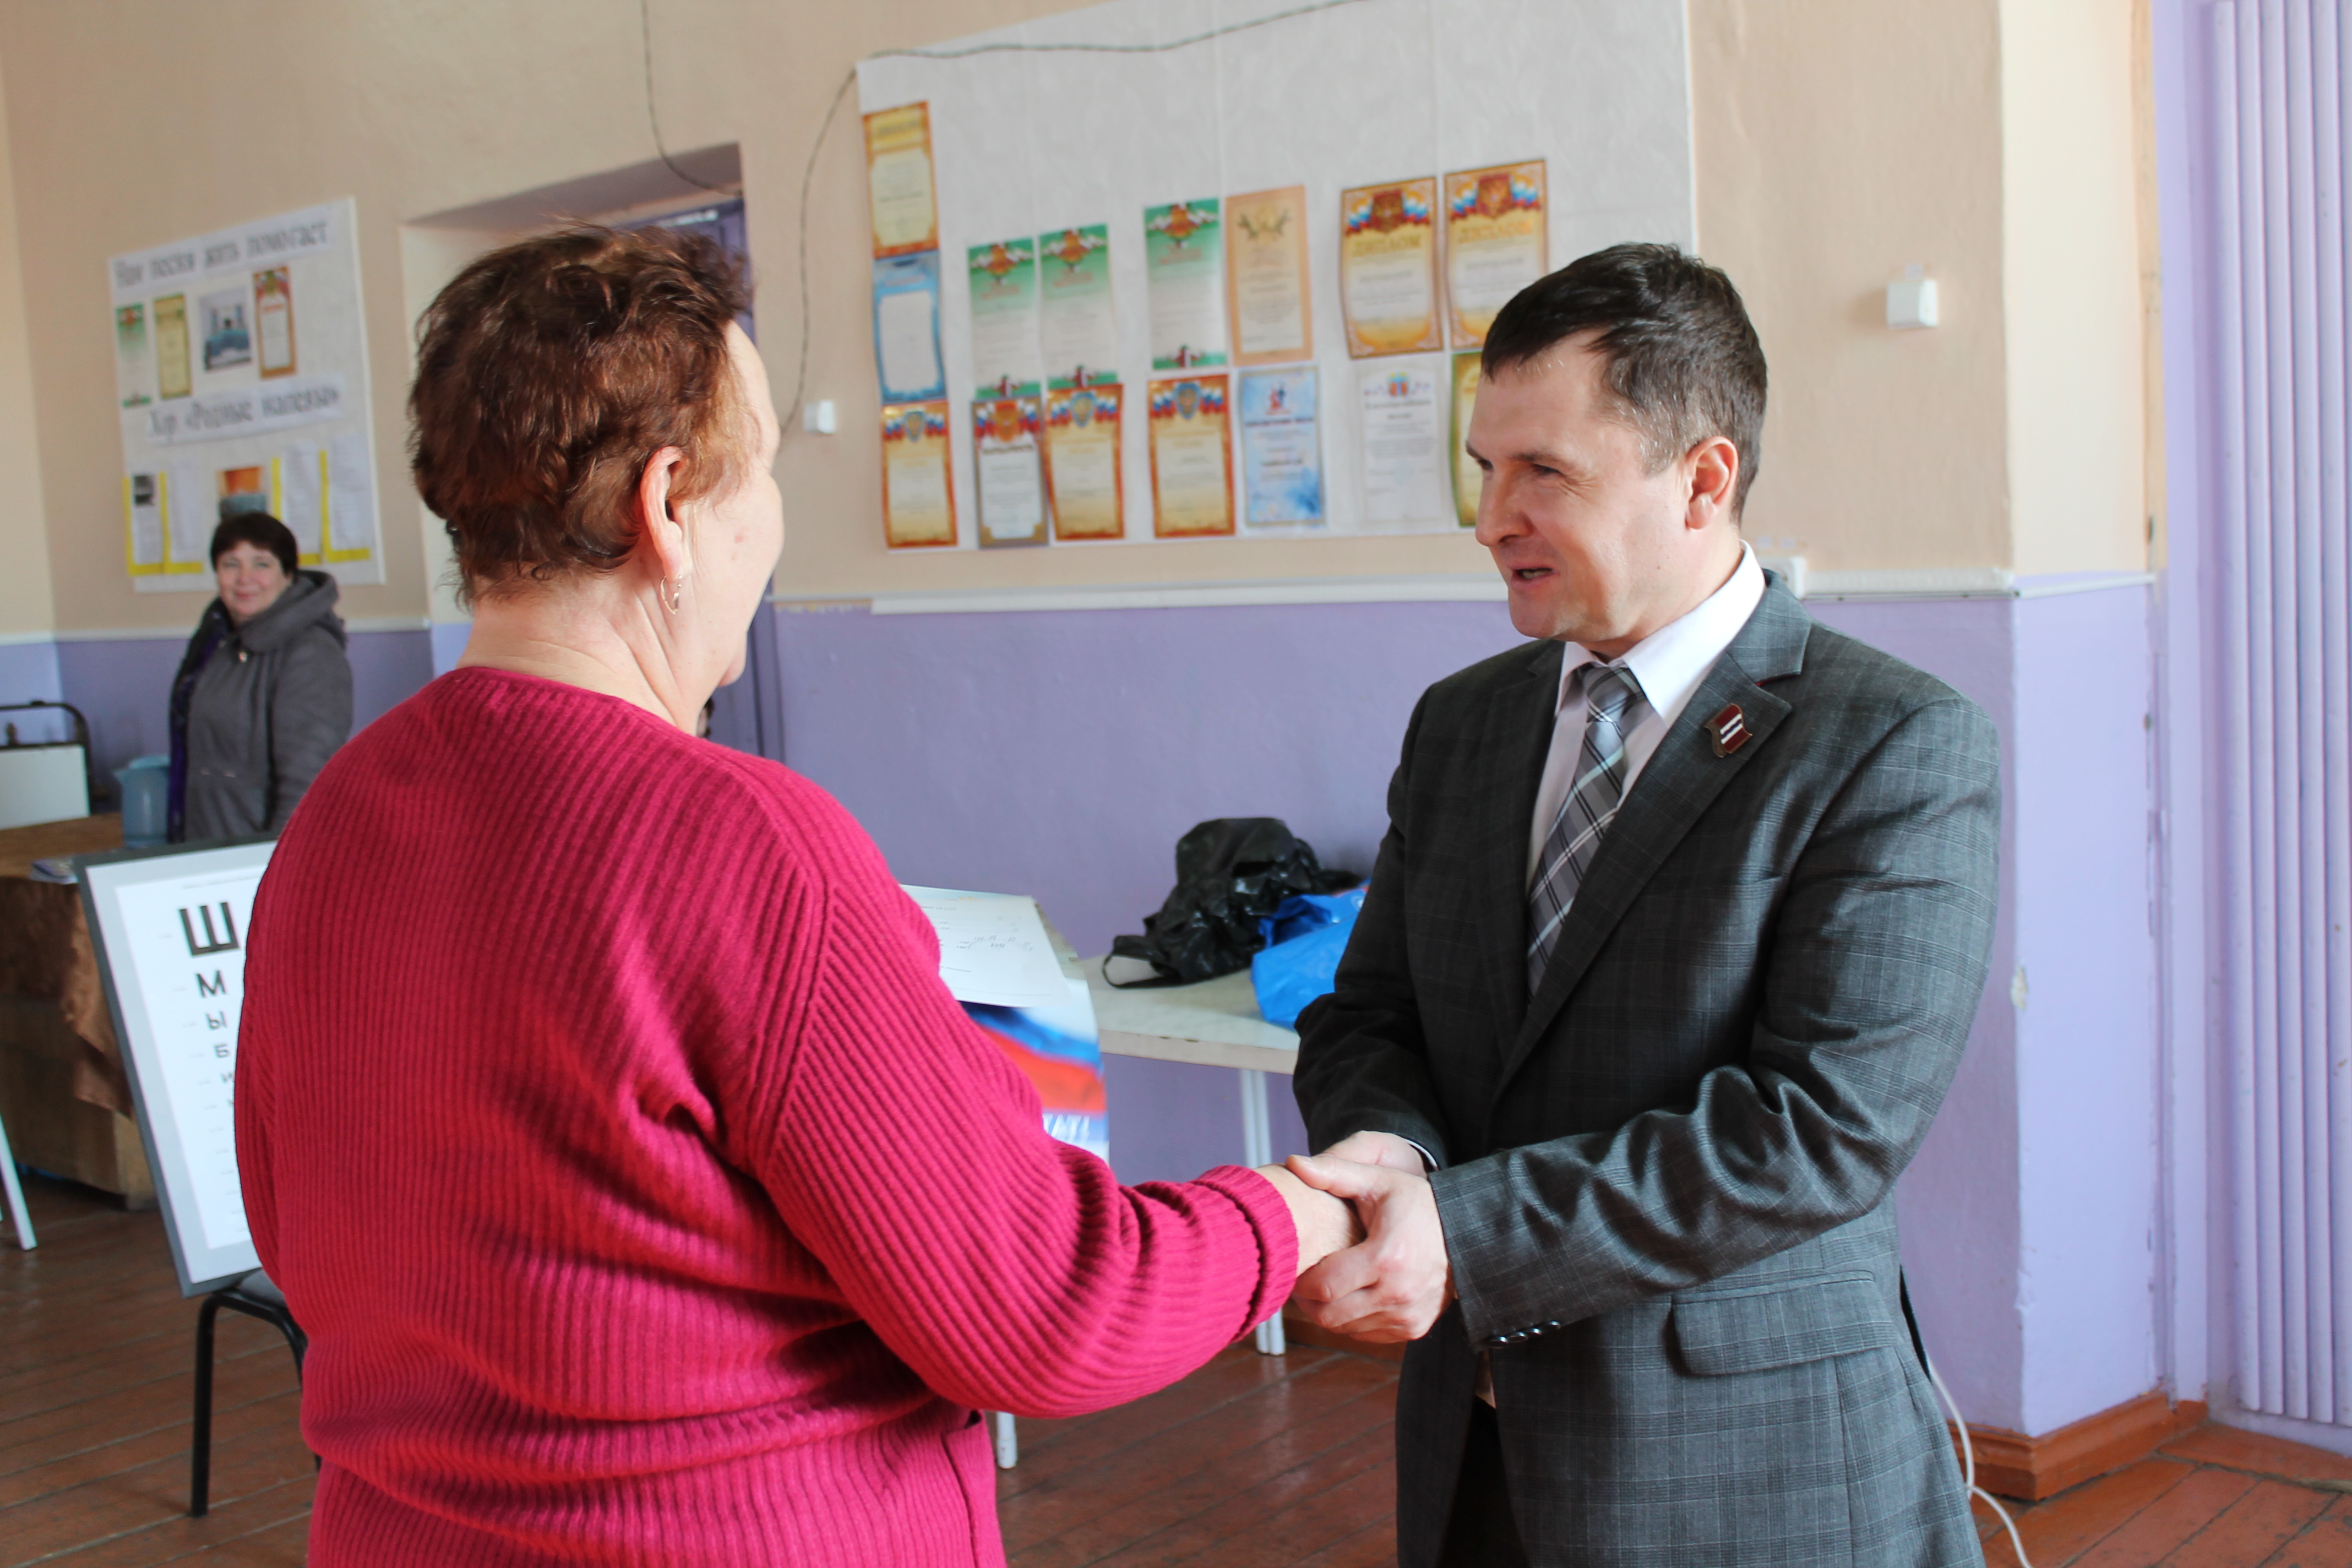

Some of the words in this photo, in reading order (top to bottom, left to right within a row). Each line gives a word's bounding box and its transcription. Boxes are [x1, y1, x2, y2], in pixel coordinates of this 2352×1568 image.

[178, 901, 240, 956] Ш
[197, 970, 227, 998] М
[206, 1010, 227, 1030] Ы
[214, 1044, 230, 1058] Б
